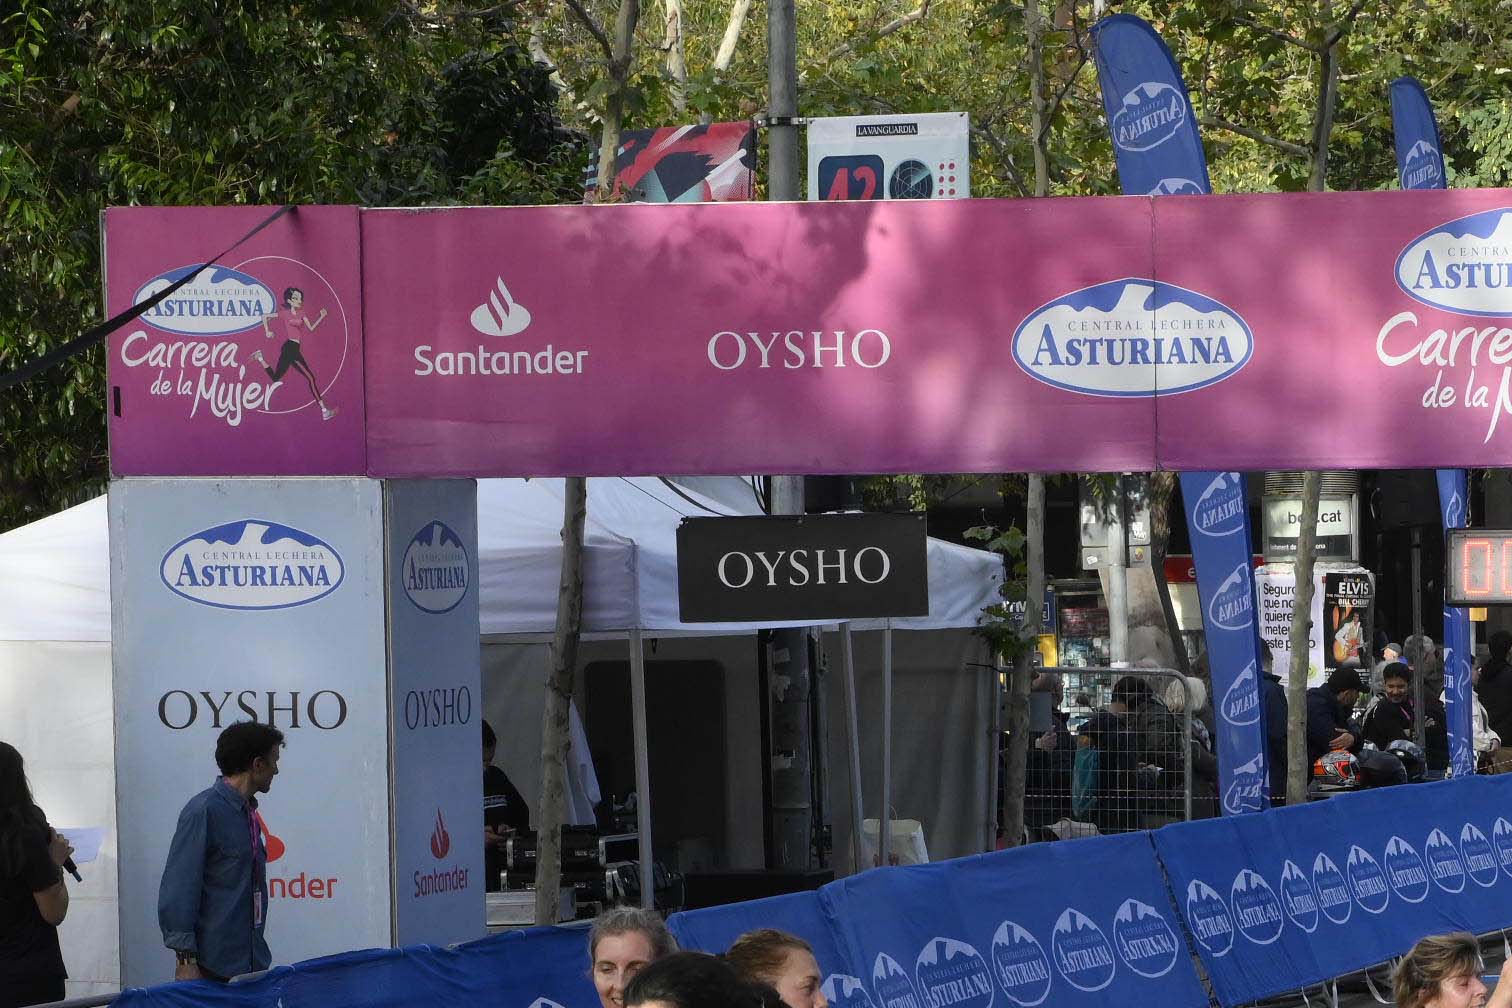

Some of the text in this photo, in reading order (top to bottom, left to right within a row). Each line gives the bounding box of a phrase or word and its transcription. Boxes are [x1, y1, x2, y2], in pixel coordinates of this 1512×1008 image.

[144, 291, 264, 318] ASTURIANA
[173, 289, 211, 297] ENTRAL
[1067, 318, 1226, 332] CENTRAL LECHERA
[120, 330, 239, 369] Carrera
[414, 344, 590, 376] Santander
[706, 328, 891, 370] OYSHO
[1031, 323, 1235, 367] ASTURIANA
[150, 363, 284, 427] de la Mujer
[1422, 369, 1456, 408] de
[1464, 369, 1489, 408] la
[175, 553, 332, 587] ASTURIANA
[203, 551, 325, 560] CENTRAL LECHERA
[717, 546, 891, 589] OYSHO
[407, 556, 465, 591] ASTURIANA
[1338, 582, 1369, 594] ELVIS
[157, 689, 348, 731] OYSHO
[404, 685, 472, 731] OYSHO
[414, 868, 469, 898] Santander
[1058, 942, 1113, 974] ASTURIANA
